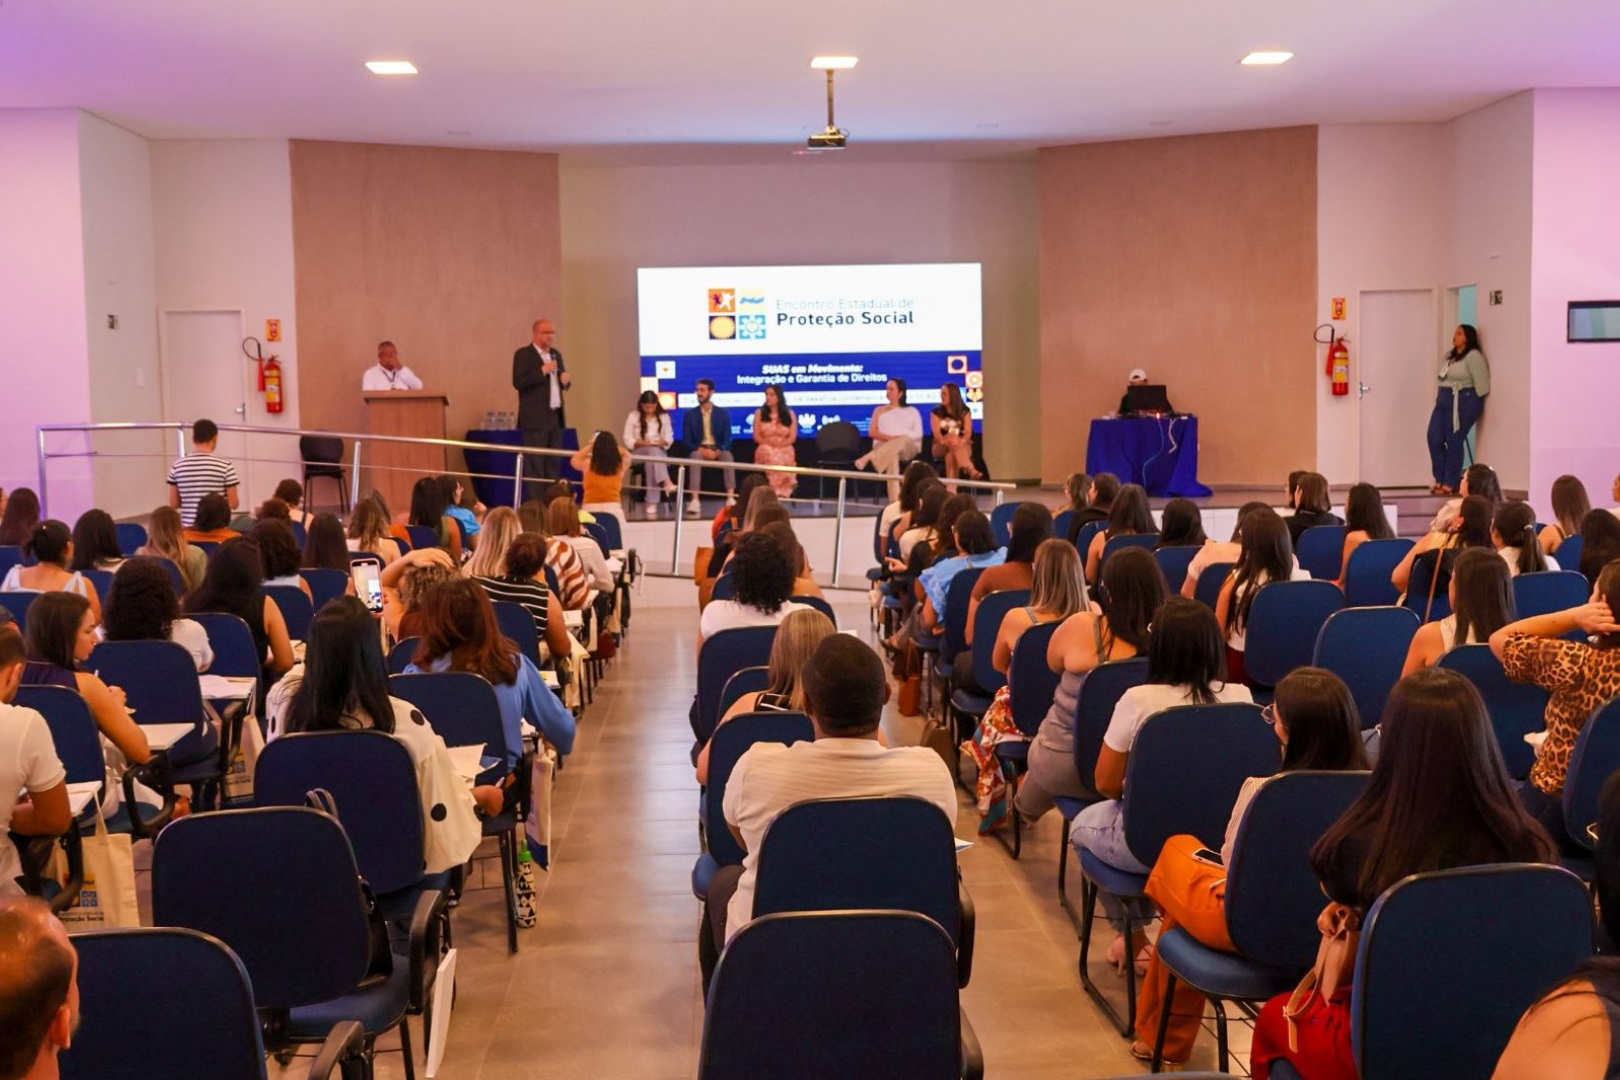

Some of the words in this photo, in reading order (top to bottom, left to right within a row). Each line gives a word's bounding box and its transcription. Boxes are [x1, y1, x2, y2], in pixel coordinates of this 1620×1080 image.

[776, 299, 833, 310] Encontro
[839, 298, 894, 309] Estadual
[898, 298, 914, 309] de
[777, 312, 855, 328] Proteção
[862, 311, 914, 324] Social
[762, 365, 789, 374] SUAS
[791, 366, 807, 374] em
[737, 375, 786, 386] Integração
[796, 374, 836, 384] Garantia
[837, 374, 849, 382] de
[851, 373, 888, 382] Direitos
